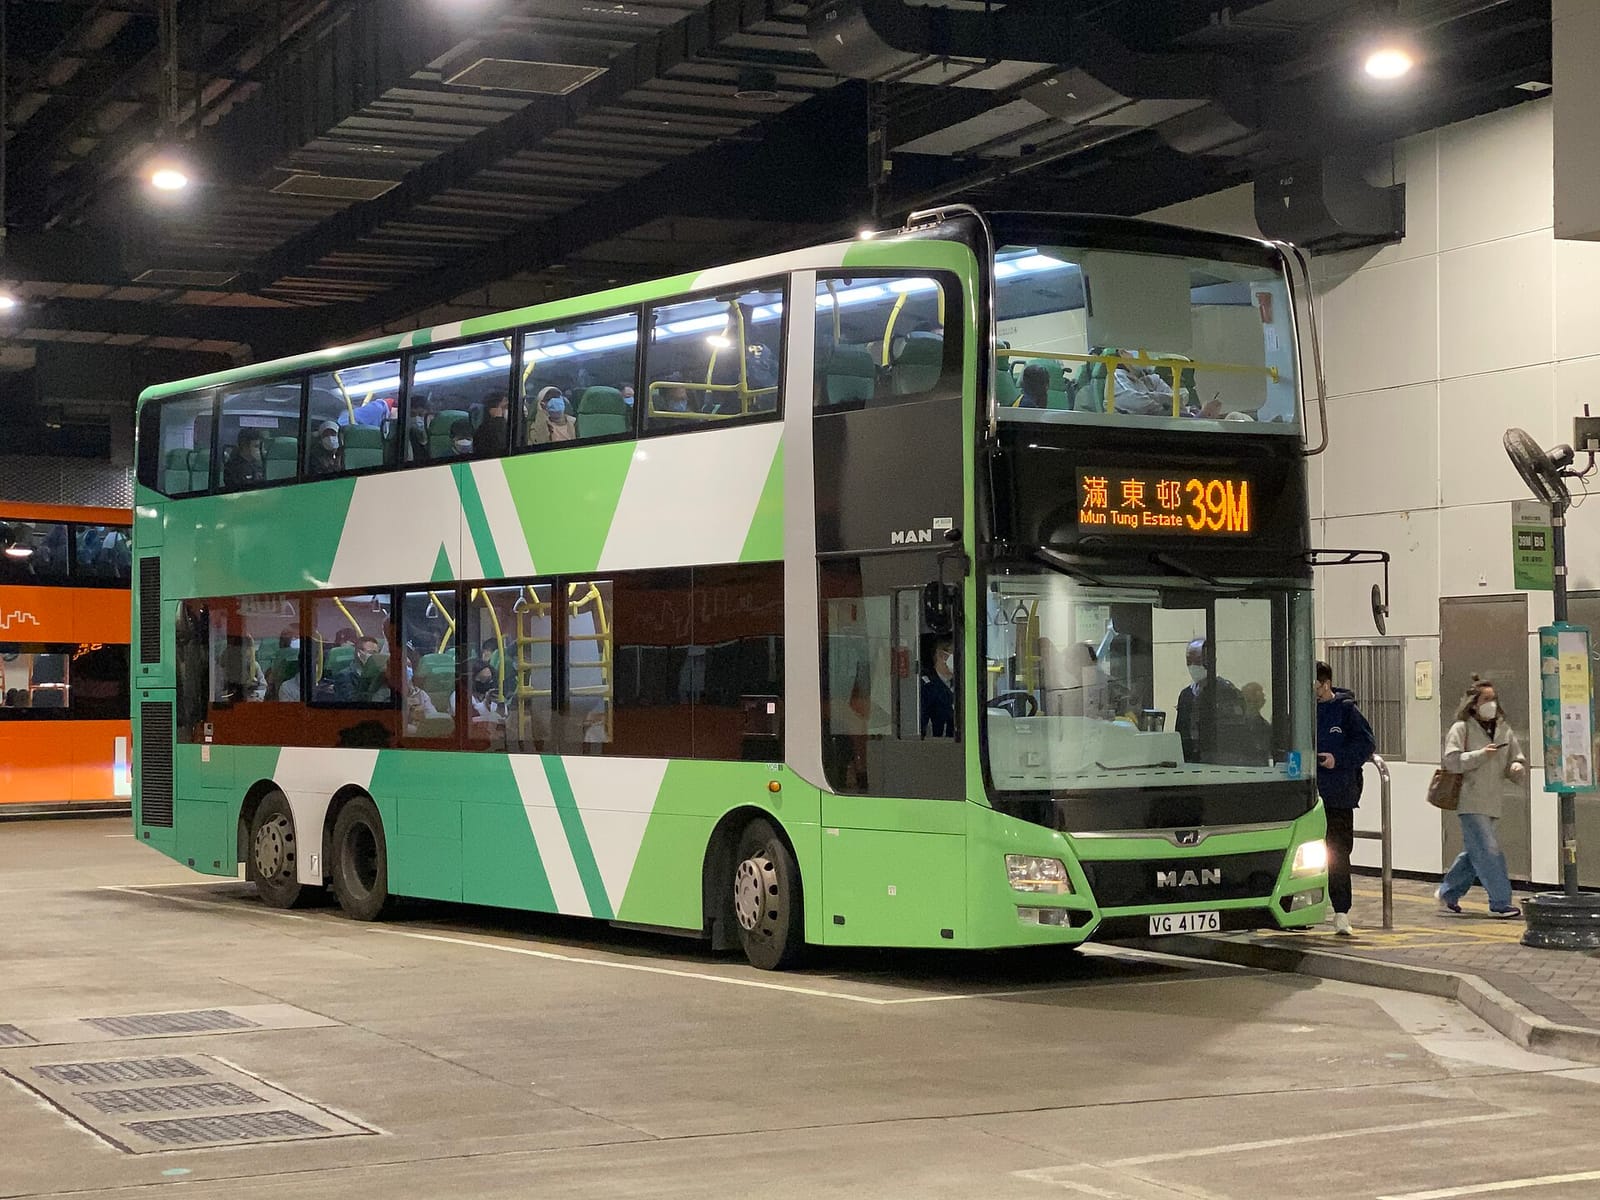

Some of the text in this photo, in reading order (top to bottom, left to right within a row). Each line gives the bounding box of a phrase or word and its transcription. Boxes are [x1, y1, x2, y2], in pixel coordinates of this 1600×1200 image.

[1081, 476, 1182, 510] 滿東邨
[1185, 478, 1249, 532] 39M
[1080, 509, 1183, 528] Mun Tung Estate
[891, 529, 932, 545] MAN
[1156, 868, 1221, 888] MAN
[1152, 913, 1217, 933] VG 4176
